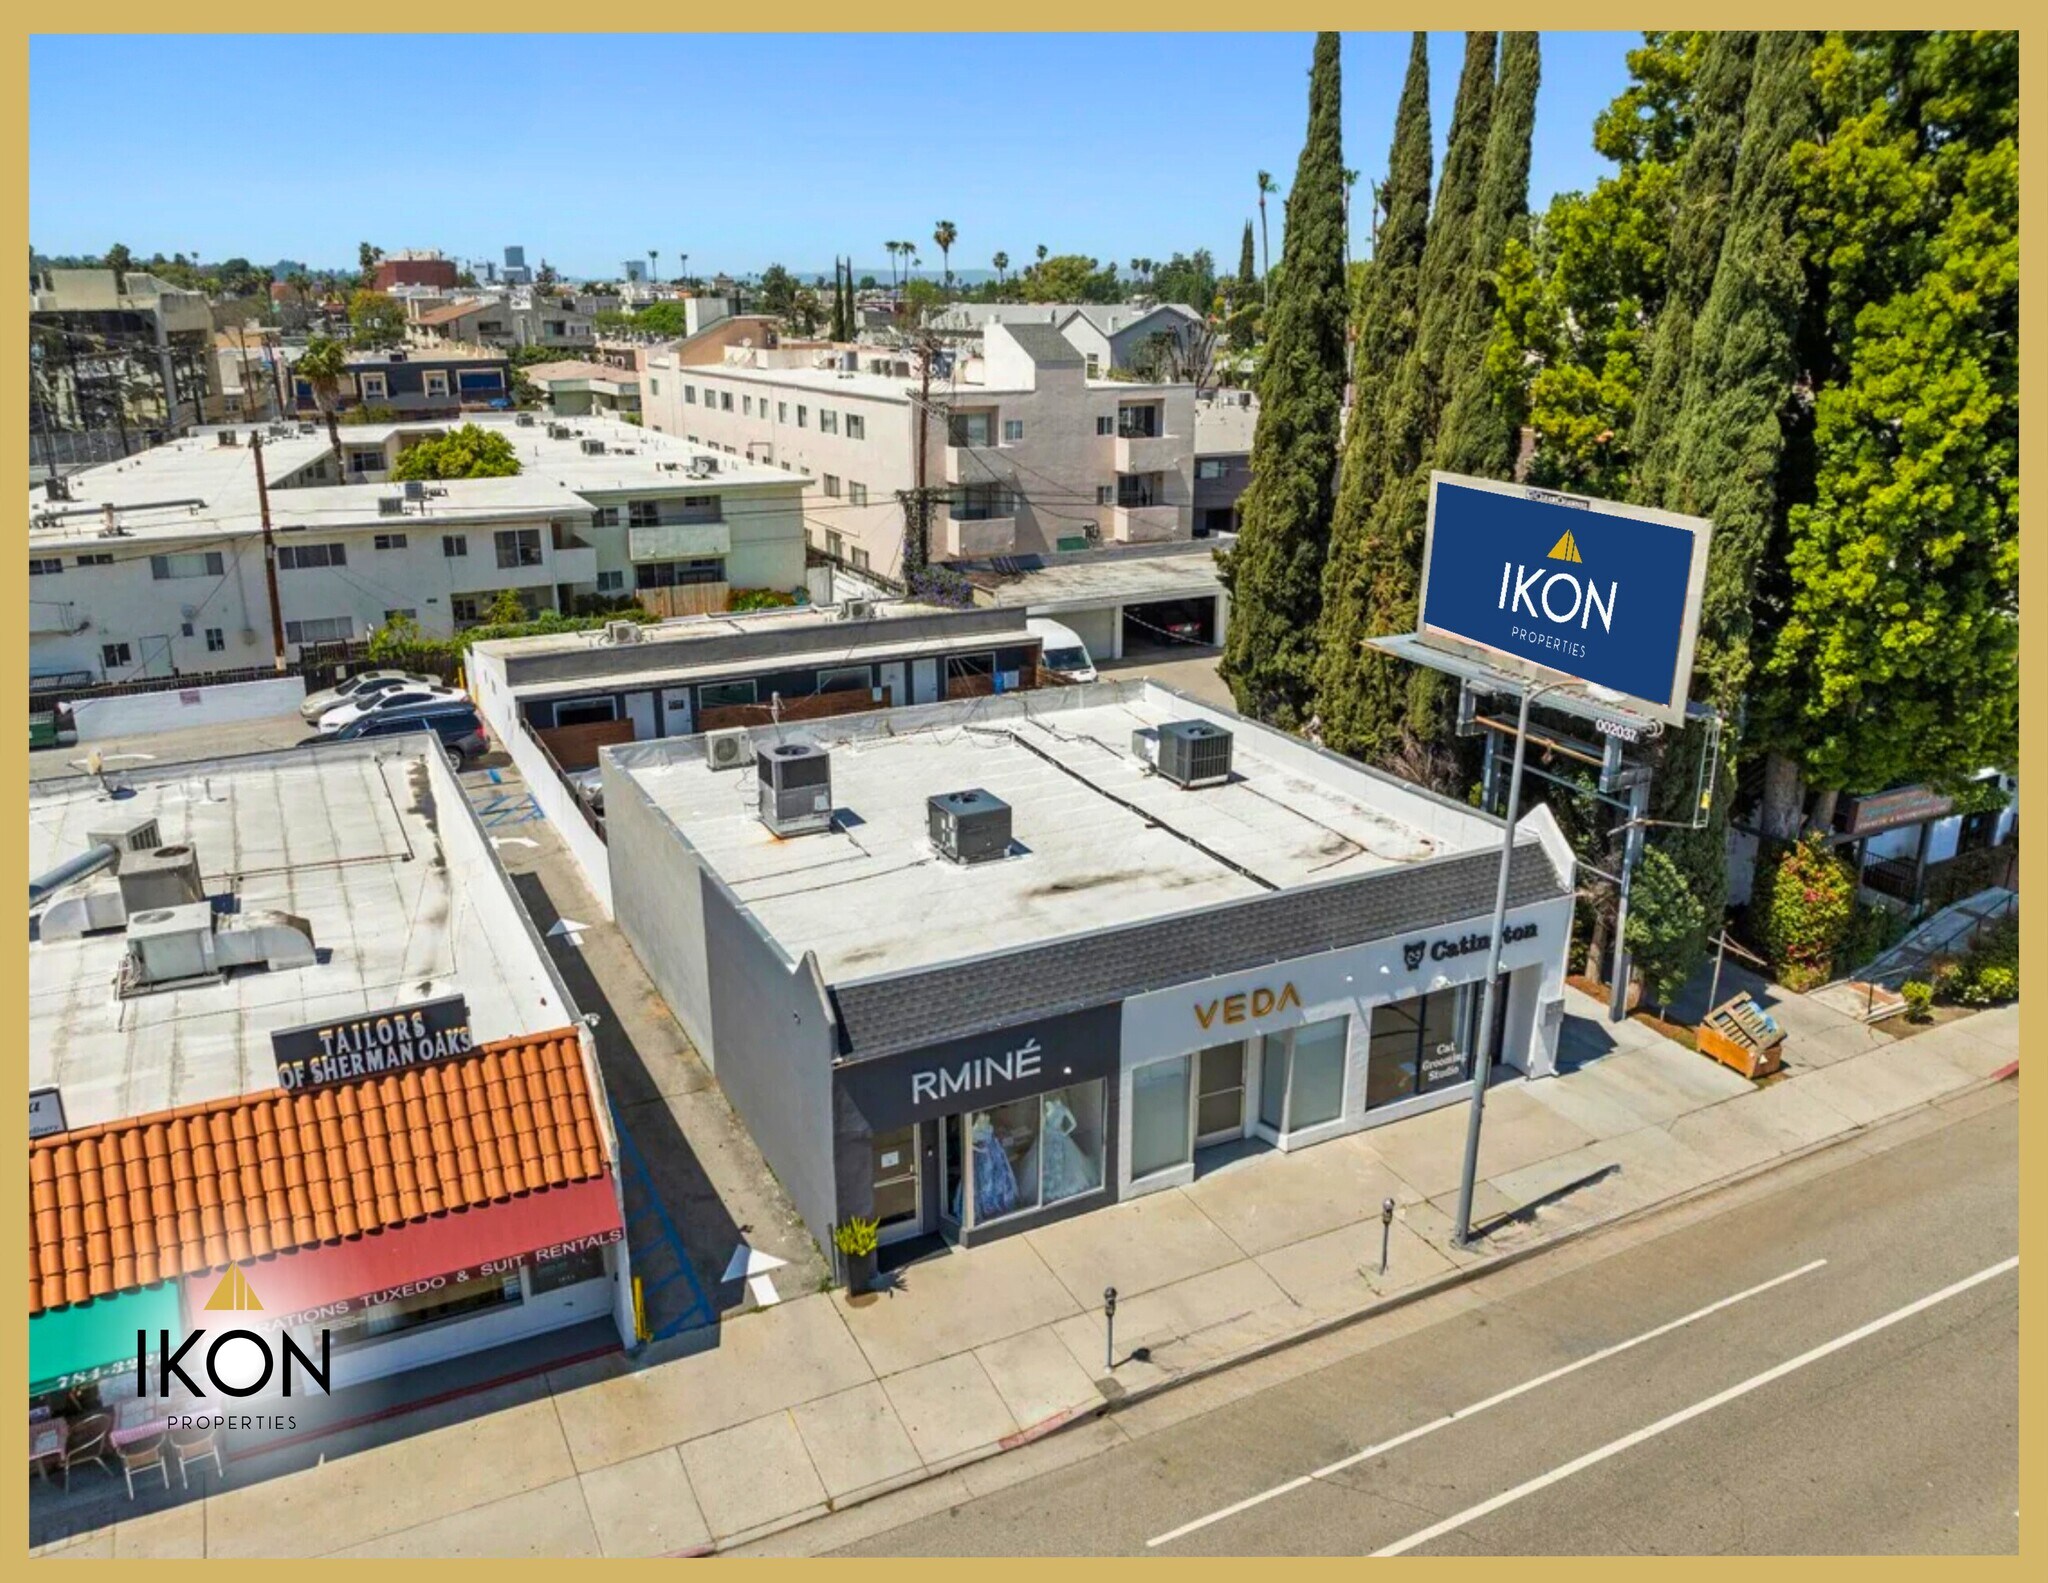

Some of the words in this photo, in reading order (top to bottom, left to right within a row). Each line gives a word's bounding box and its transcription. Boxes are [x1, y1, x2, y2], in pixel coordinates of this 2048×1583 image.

[1498, 562, 1618, 634] IKON
[1511, 626, 1586, 658] PROPERTIES
[1430, 922, 1539, 961] Catinton
[1194, 981, 1301, 1030] VEDA
[318, 1011, 426, 1057] TAILORS
[1436, 1041, 1457, 1056] Cat
[278, 1060, 306, 1090] OF
[309, 1042, 414, 1084] SHERMAN
[418, 1026, 472, 1062] OAKS
[911, 1038, 1042, 1104] RMINÉ
[1427, 1065, 1460, 1081] Studio
[255, 1300, 350, 1332] RATIONS
[359, 1274, 446, 1308] TUXEDO
[455, 1269, 471, 1283] &
[480, 1254, 526, 1278] SUIT
[536, 1229, 623, 1262] RENTALS
